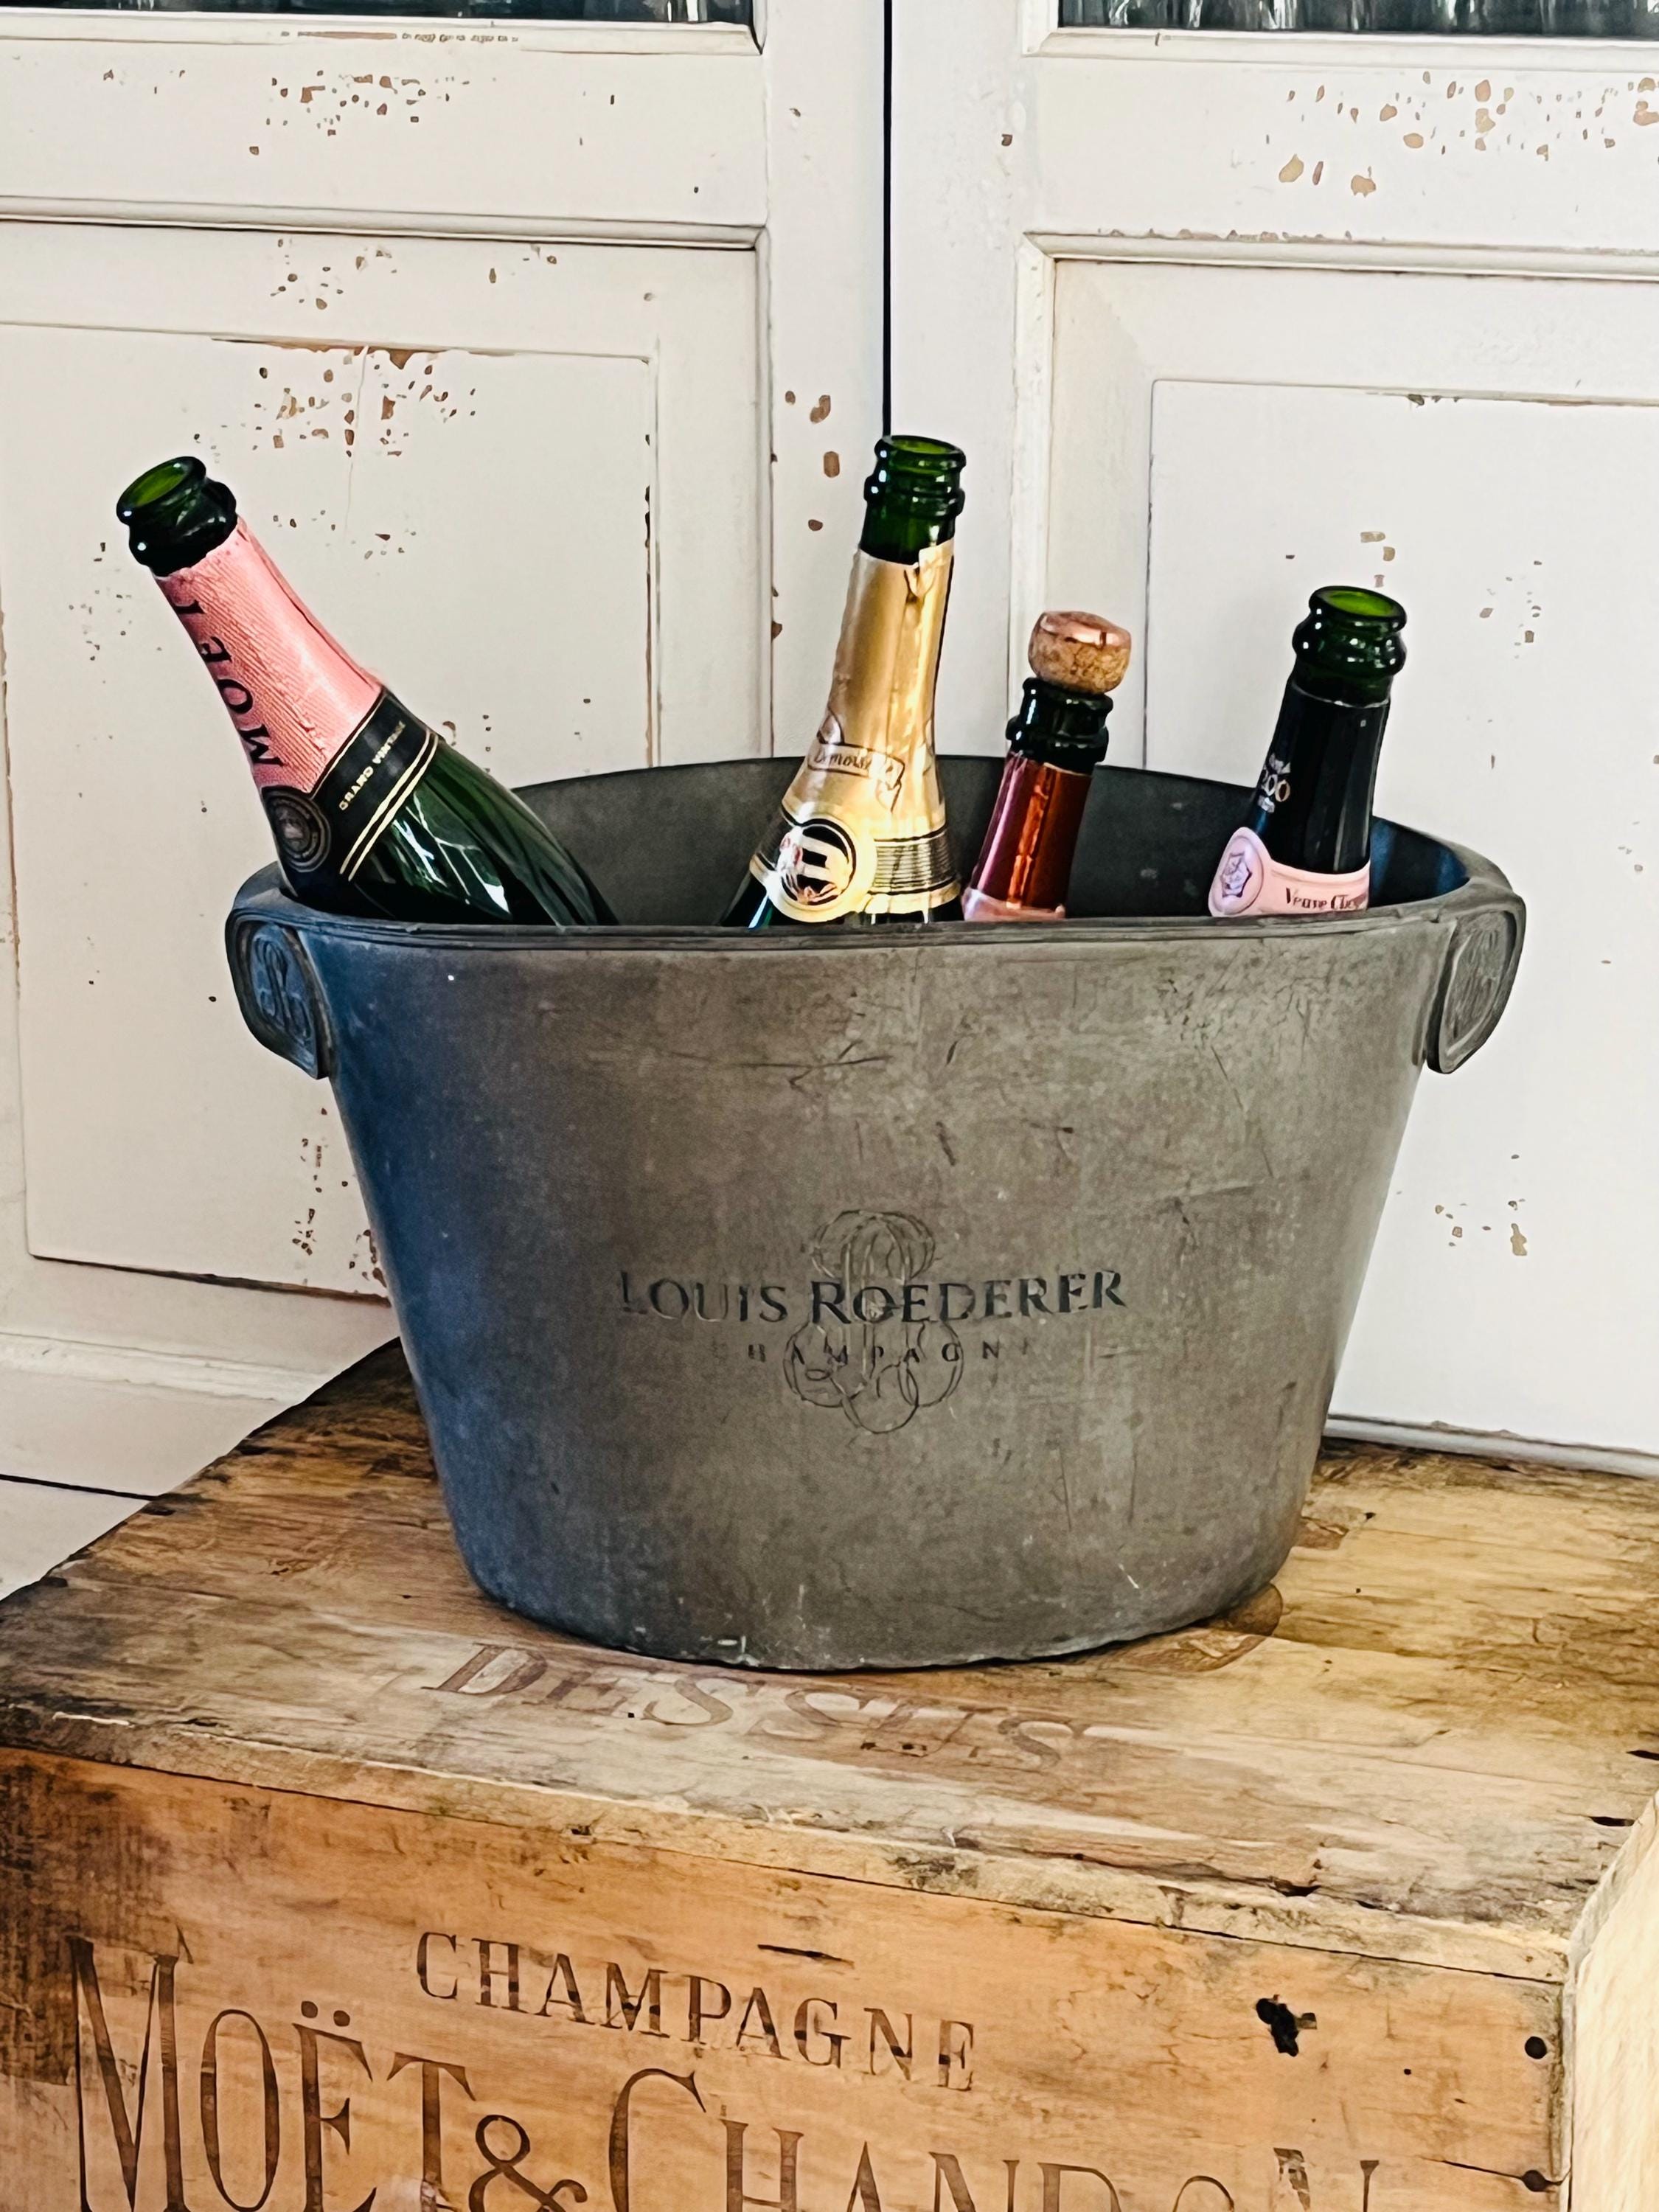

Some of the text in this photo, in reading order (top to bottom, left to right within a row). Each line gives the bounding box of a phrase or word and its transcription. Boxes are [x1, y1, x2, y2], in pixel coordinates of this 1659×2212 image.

[339, 765, 374, 810] GRAND
[619, 1269, 1127, 1325] LOUIS ROEDERER
[748, 1335, 1029, 1366] HAMPAGN
[417, 1931, 975, 2092] CHAMPAGNE
[468, 2114, 588, 2212] &
